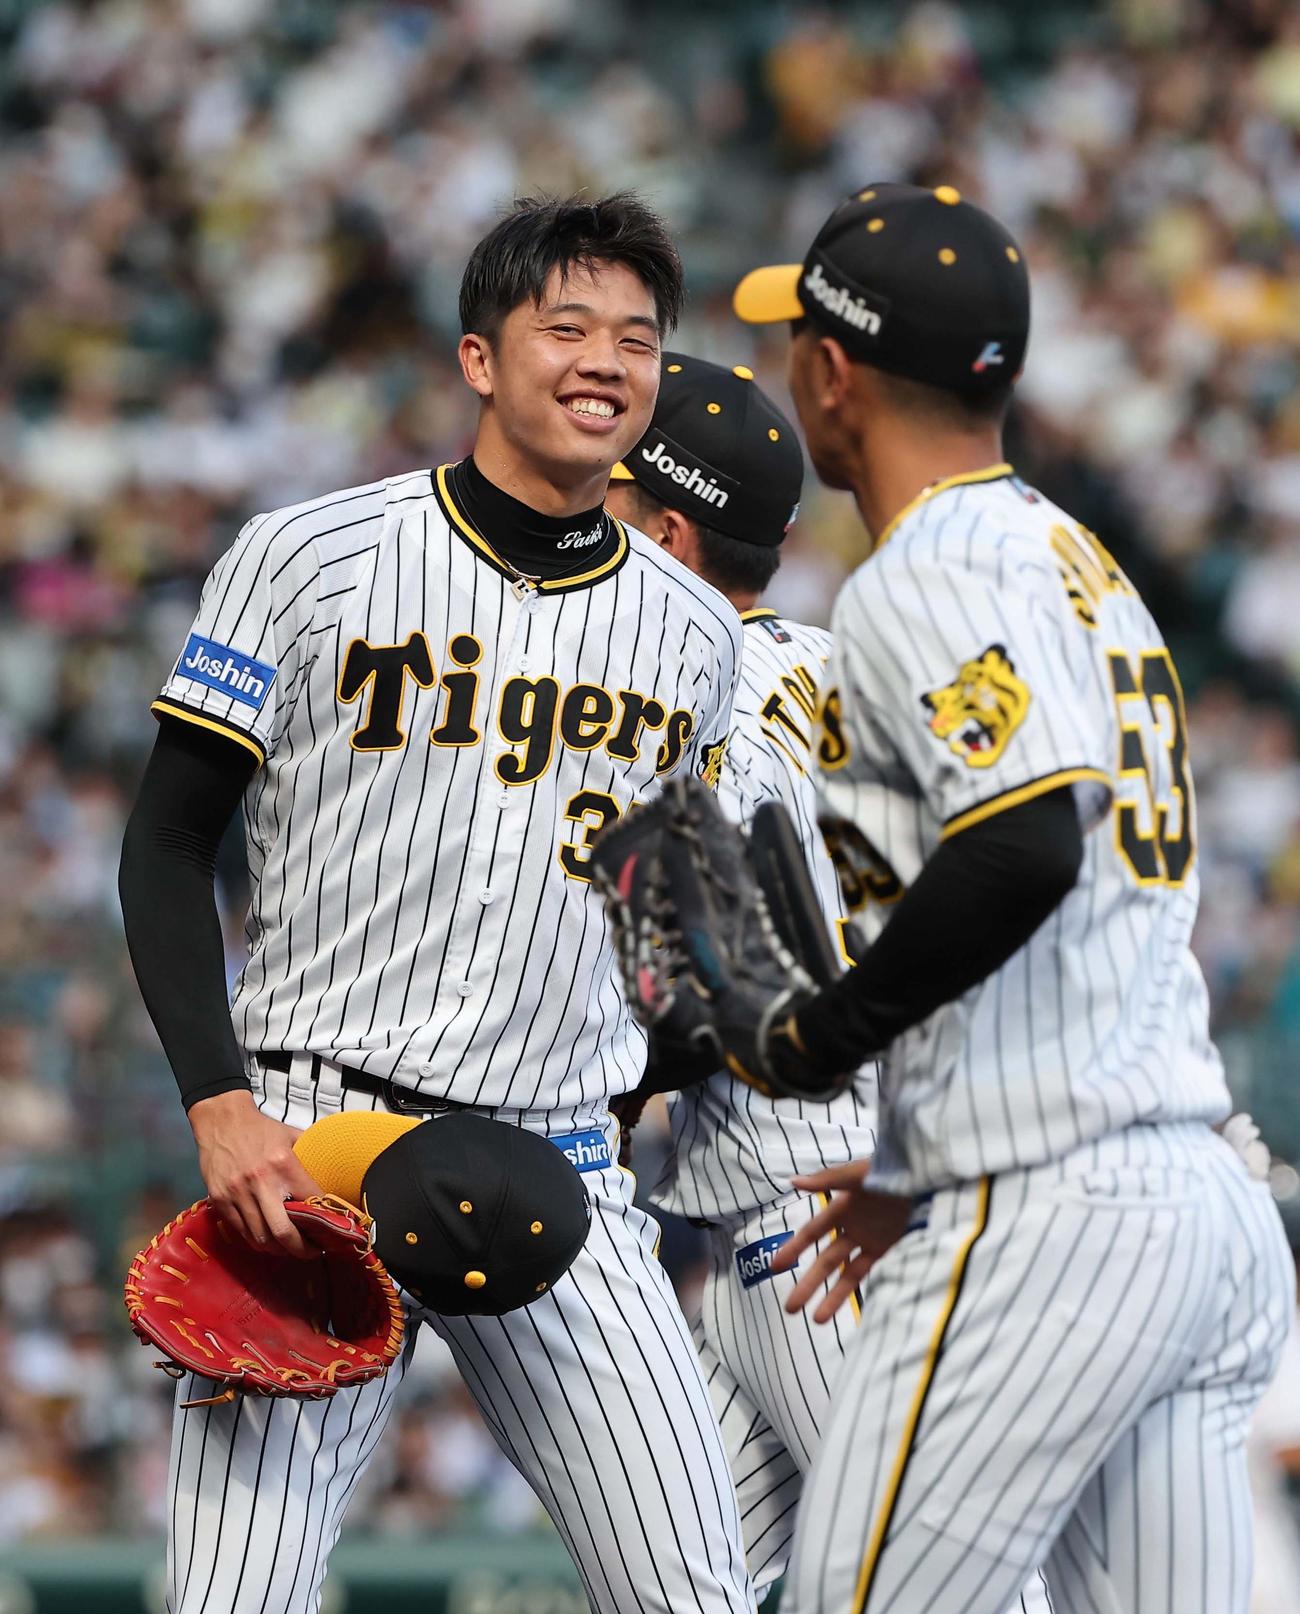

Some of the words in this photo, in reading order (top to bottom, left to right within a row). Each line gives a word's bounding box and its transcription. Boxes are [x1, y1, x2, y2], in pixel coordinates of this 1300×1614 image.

[804, 264, 882, 336] Joshin
[641, 442, 730, 510] Joshin
[185, 645, 265, 698] Joshin
[337, 629, 694, 787] Tigers
[1106, 647, 1198, 888] 53
[557, 789, 645, 884] 3
[563, 1138, 608, 1166] shin
[740, 1242, 779, 1280] Joshi
